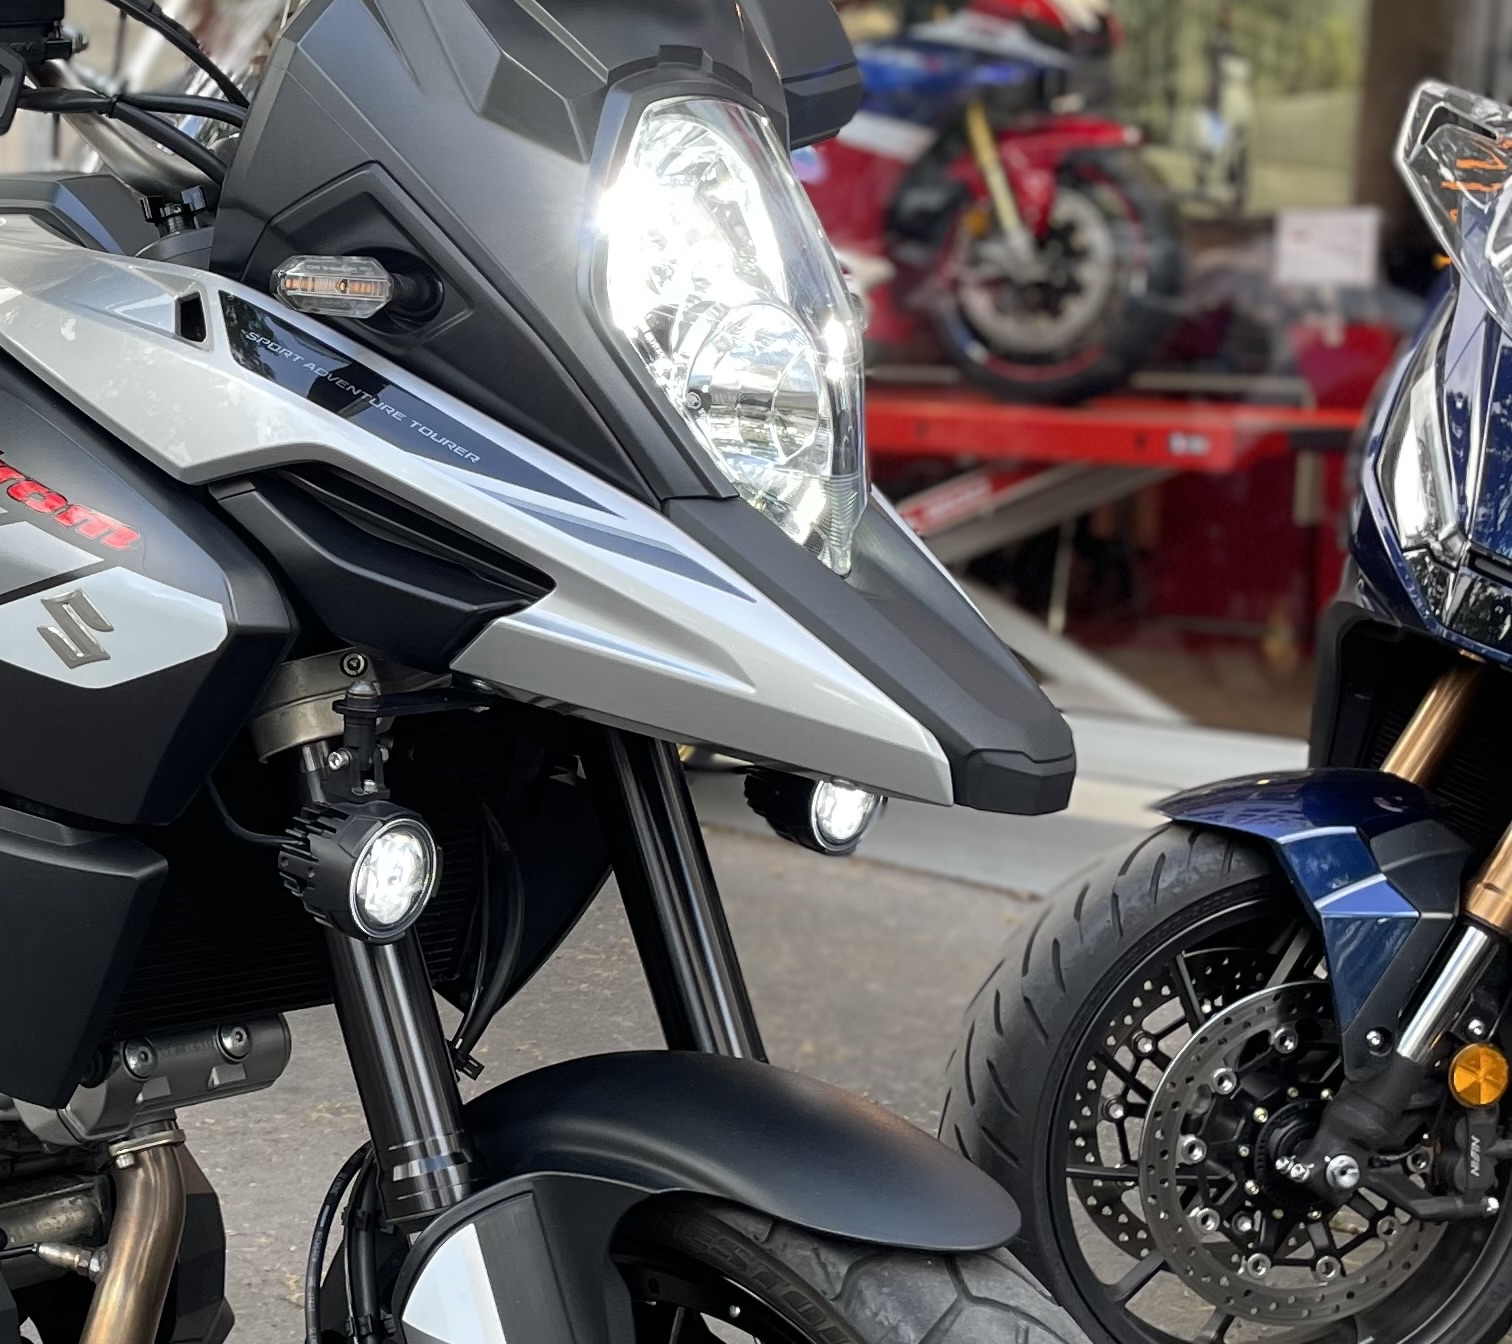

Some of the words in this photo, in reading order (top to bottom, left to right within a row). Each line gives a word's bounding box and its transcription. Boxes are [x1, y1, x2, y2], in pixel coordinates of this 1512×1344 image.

[245, 331, 304, 363] SPORT
[303, 362, 407, 422] ADVENTURE
[411, 419, 481, 464] TOURER
